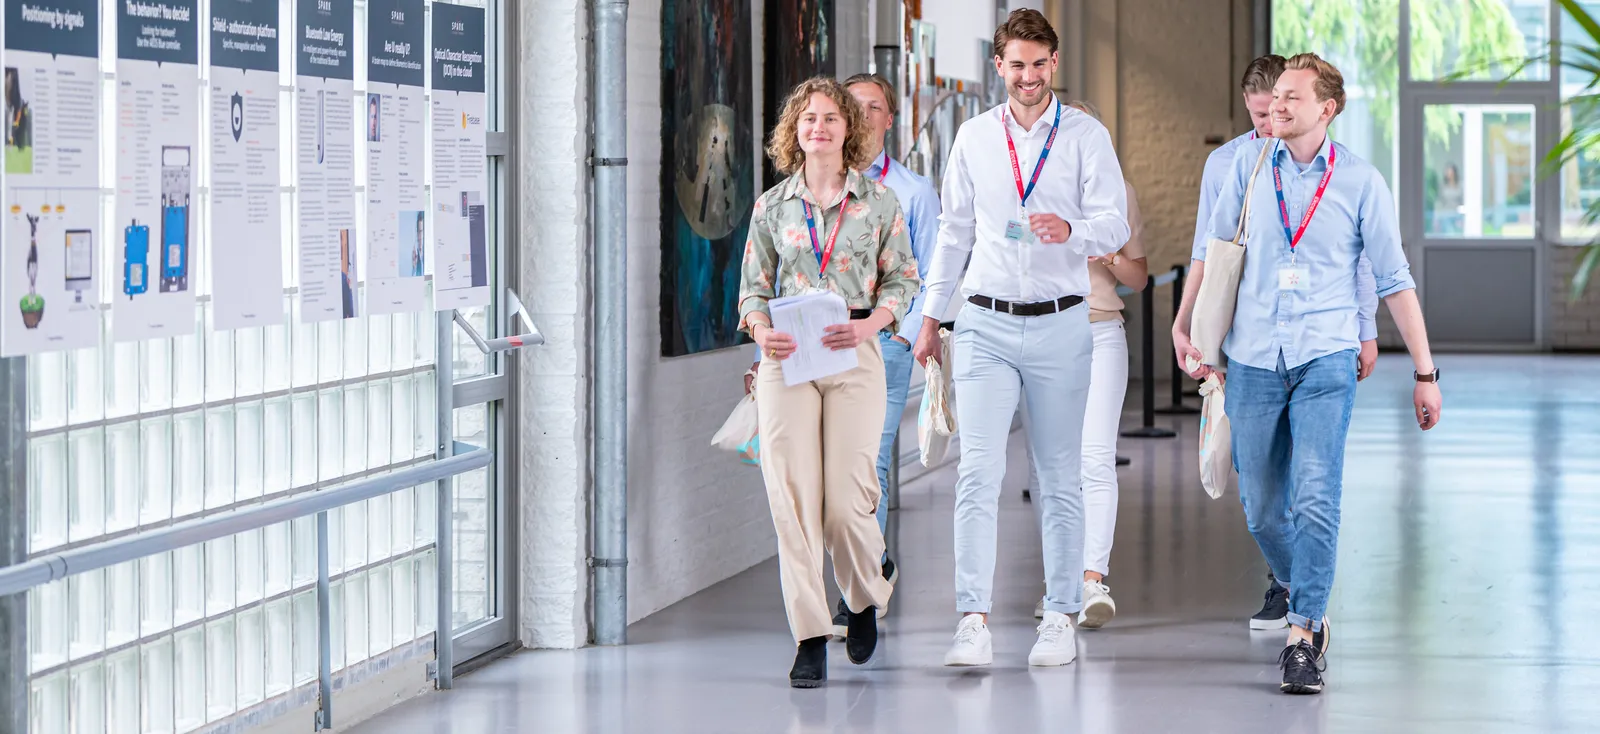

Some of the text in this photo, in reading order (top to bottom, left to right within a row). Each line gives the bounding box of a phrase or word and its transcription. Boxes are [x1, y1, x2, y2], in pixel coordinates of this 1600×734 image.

[126, 0, 136, 16] The
[162, 4, 172, 20] You
[318, 0, 331, 10] SPARK
[22, 4, 84, 30] Positioning by signals
[391, 10, 404, 21] SPARK
[212, 16, 226, 32] Shield
[229, 20, 256, 36] authorization
[257, 23, 276, 40] platform
[306, 25, 322, 40] Bluetooth
[331, 28, 344, 46] Energy
[452, 22, 464, 31] SPARK
[434, 48, 482, 65] Optical Character Recognition
[1010, 150, 1020, 181] EXCELLENCE
[1301, 196, 1319, 228] EXCELLENCE
